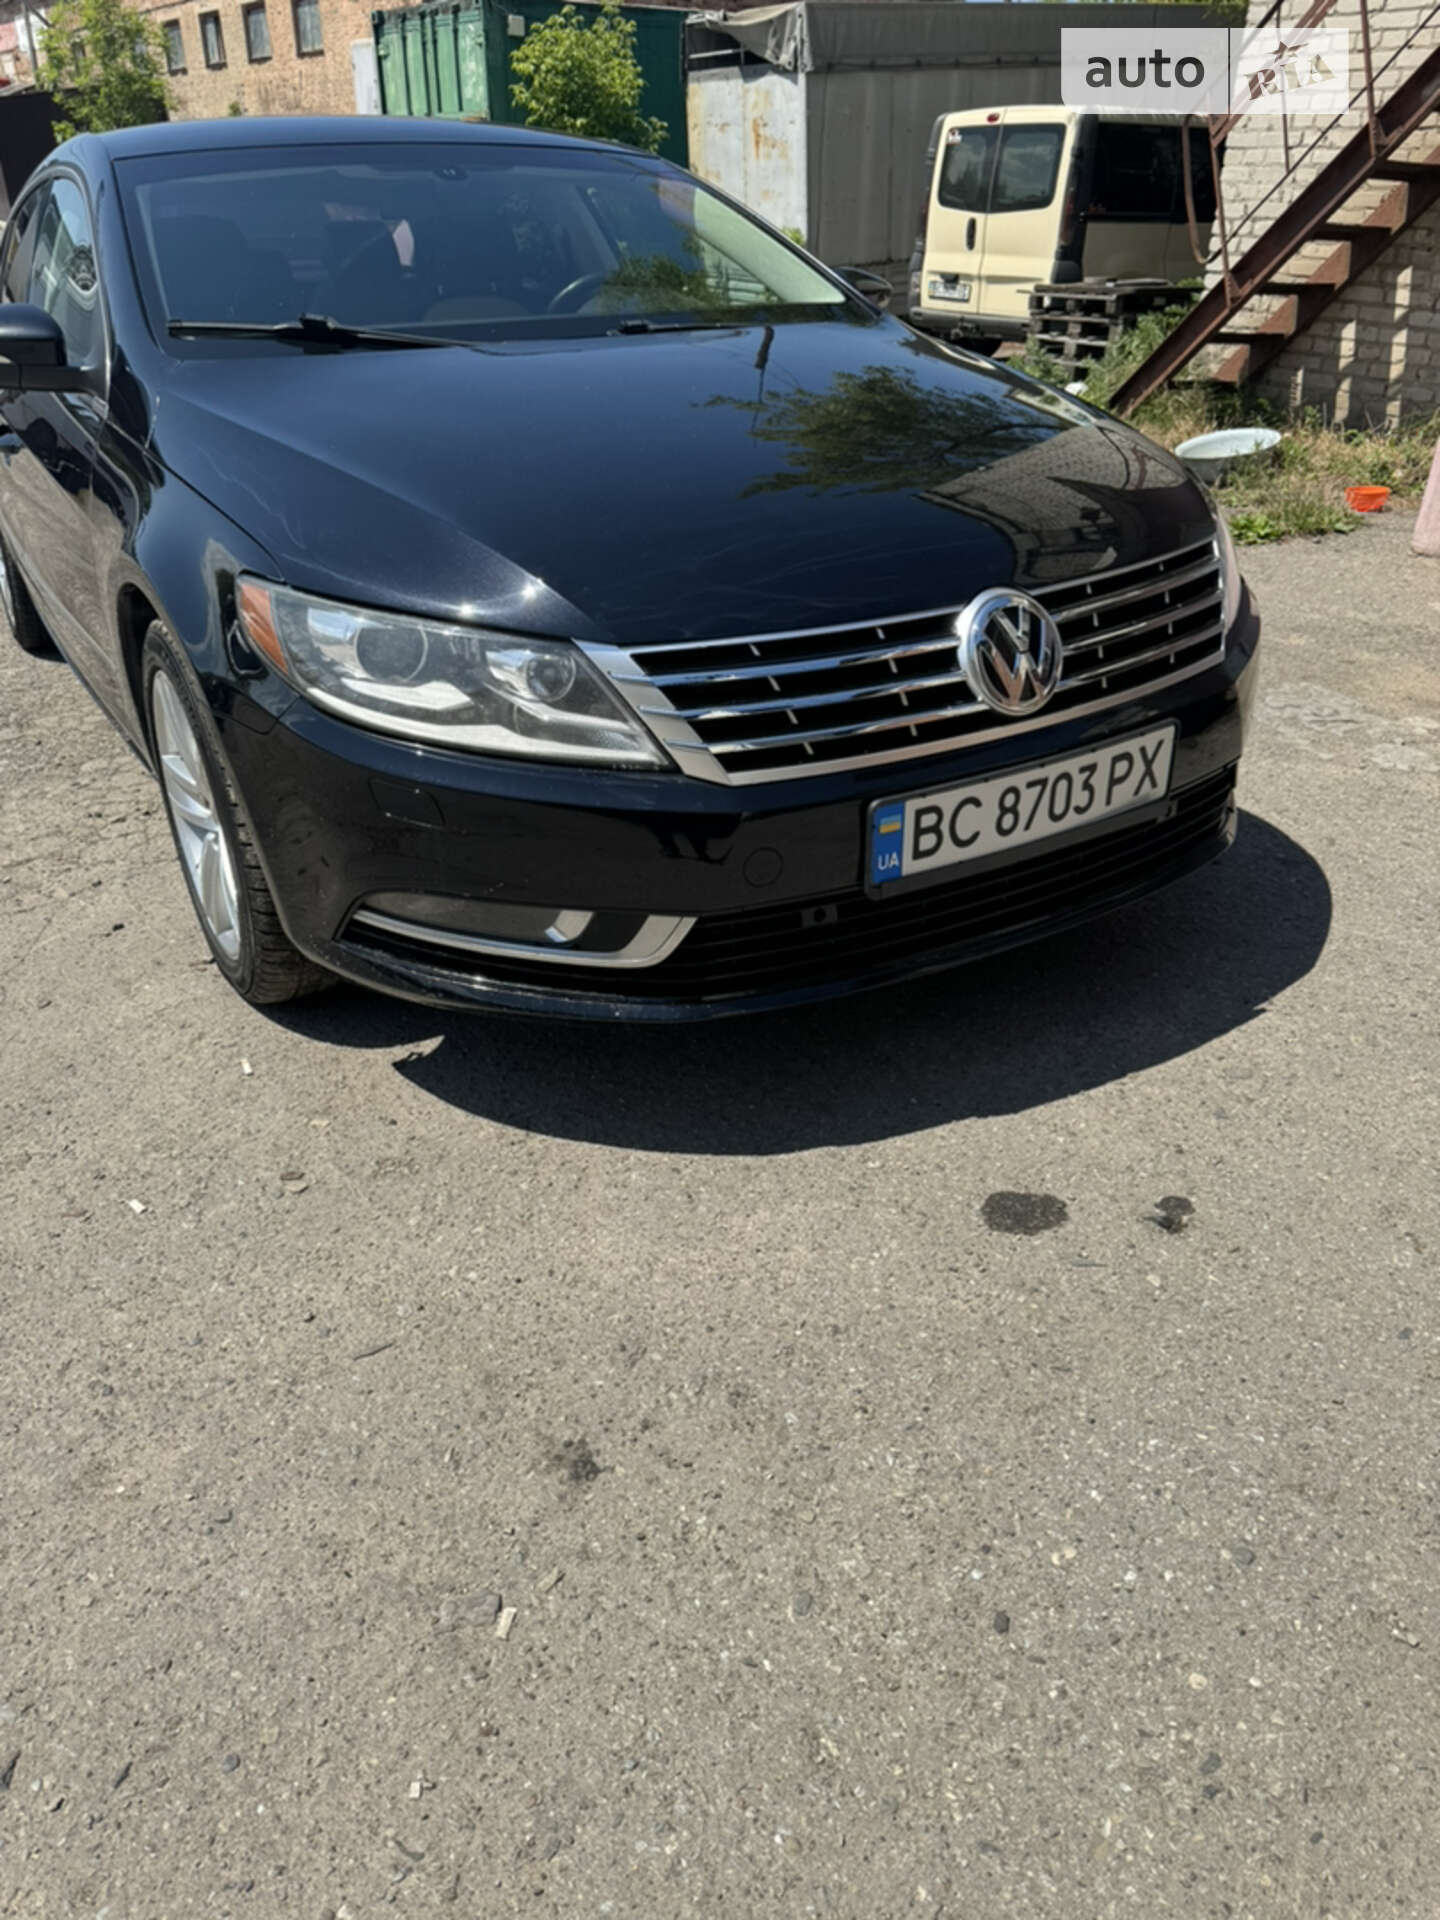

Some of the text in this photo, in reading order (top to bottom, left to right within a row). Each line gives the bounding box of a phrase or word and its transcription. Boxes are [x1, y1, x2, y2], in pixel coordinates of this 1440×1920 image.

[912, 740, 1165, 861] BC 8703 PX
[878, 852, 900, 870] UA
